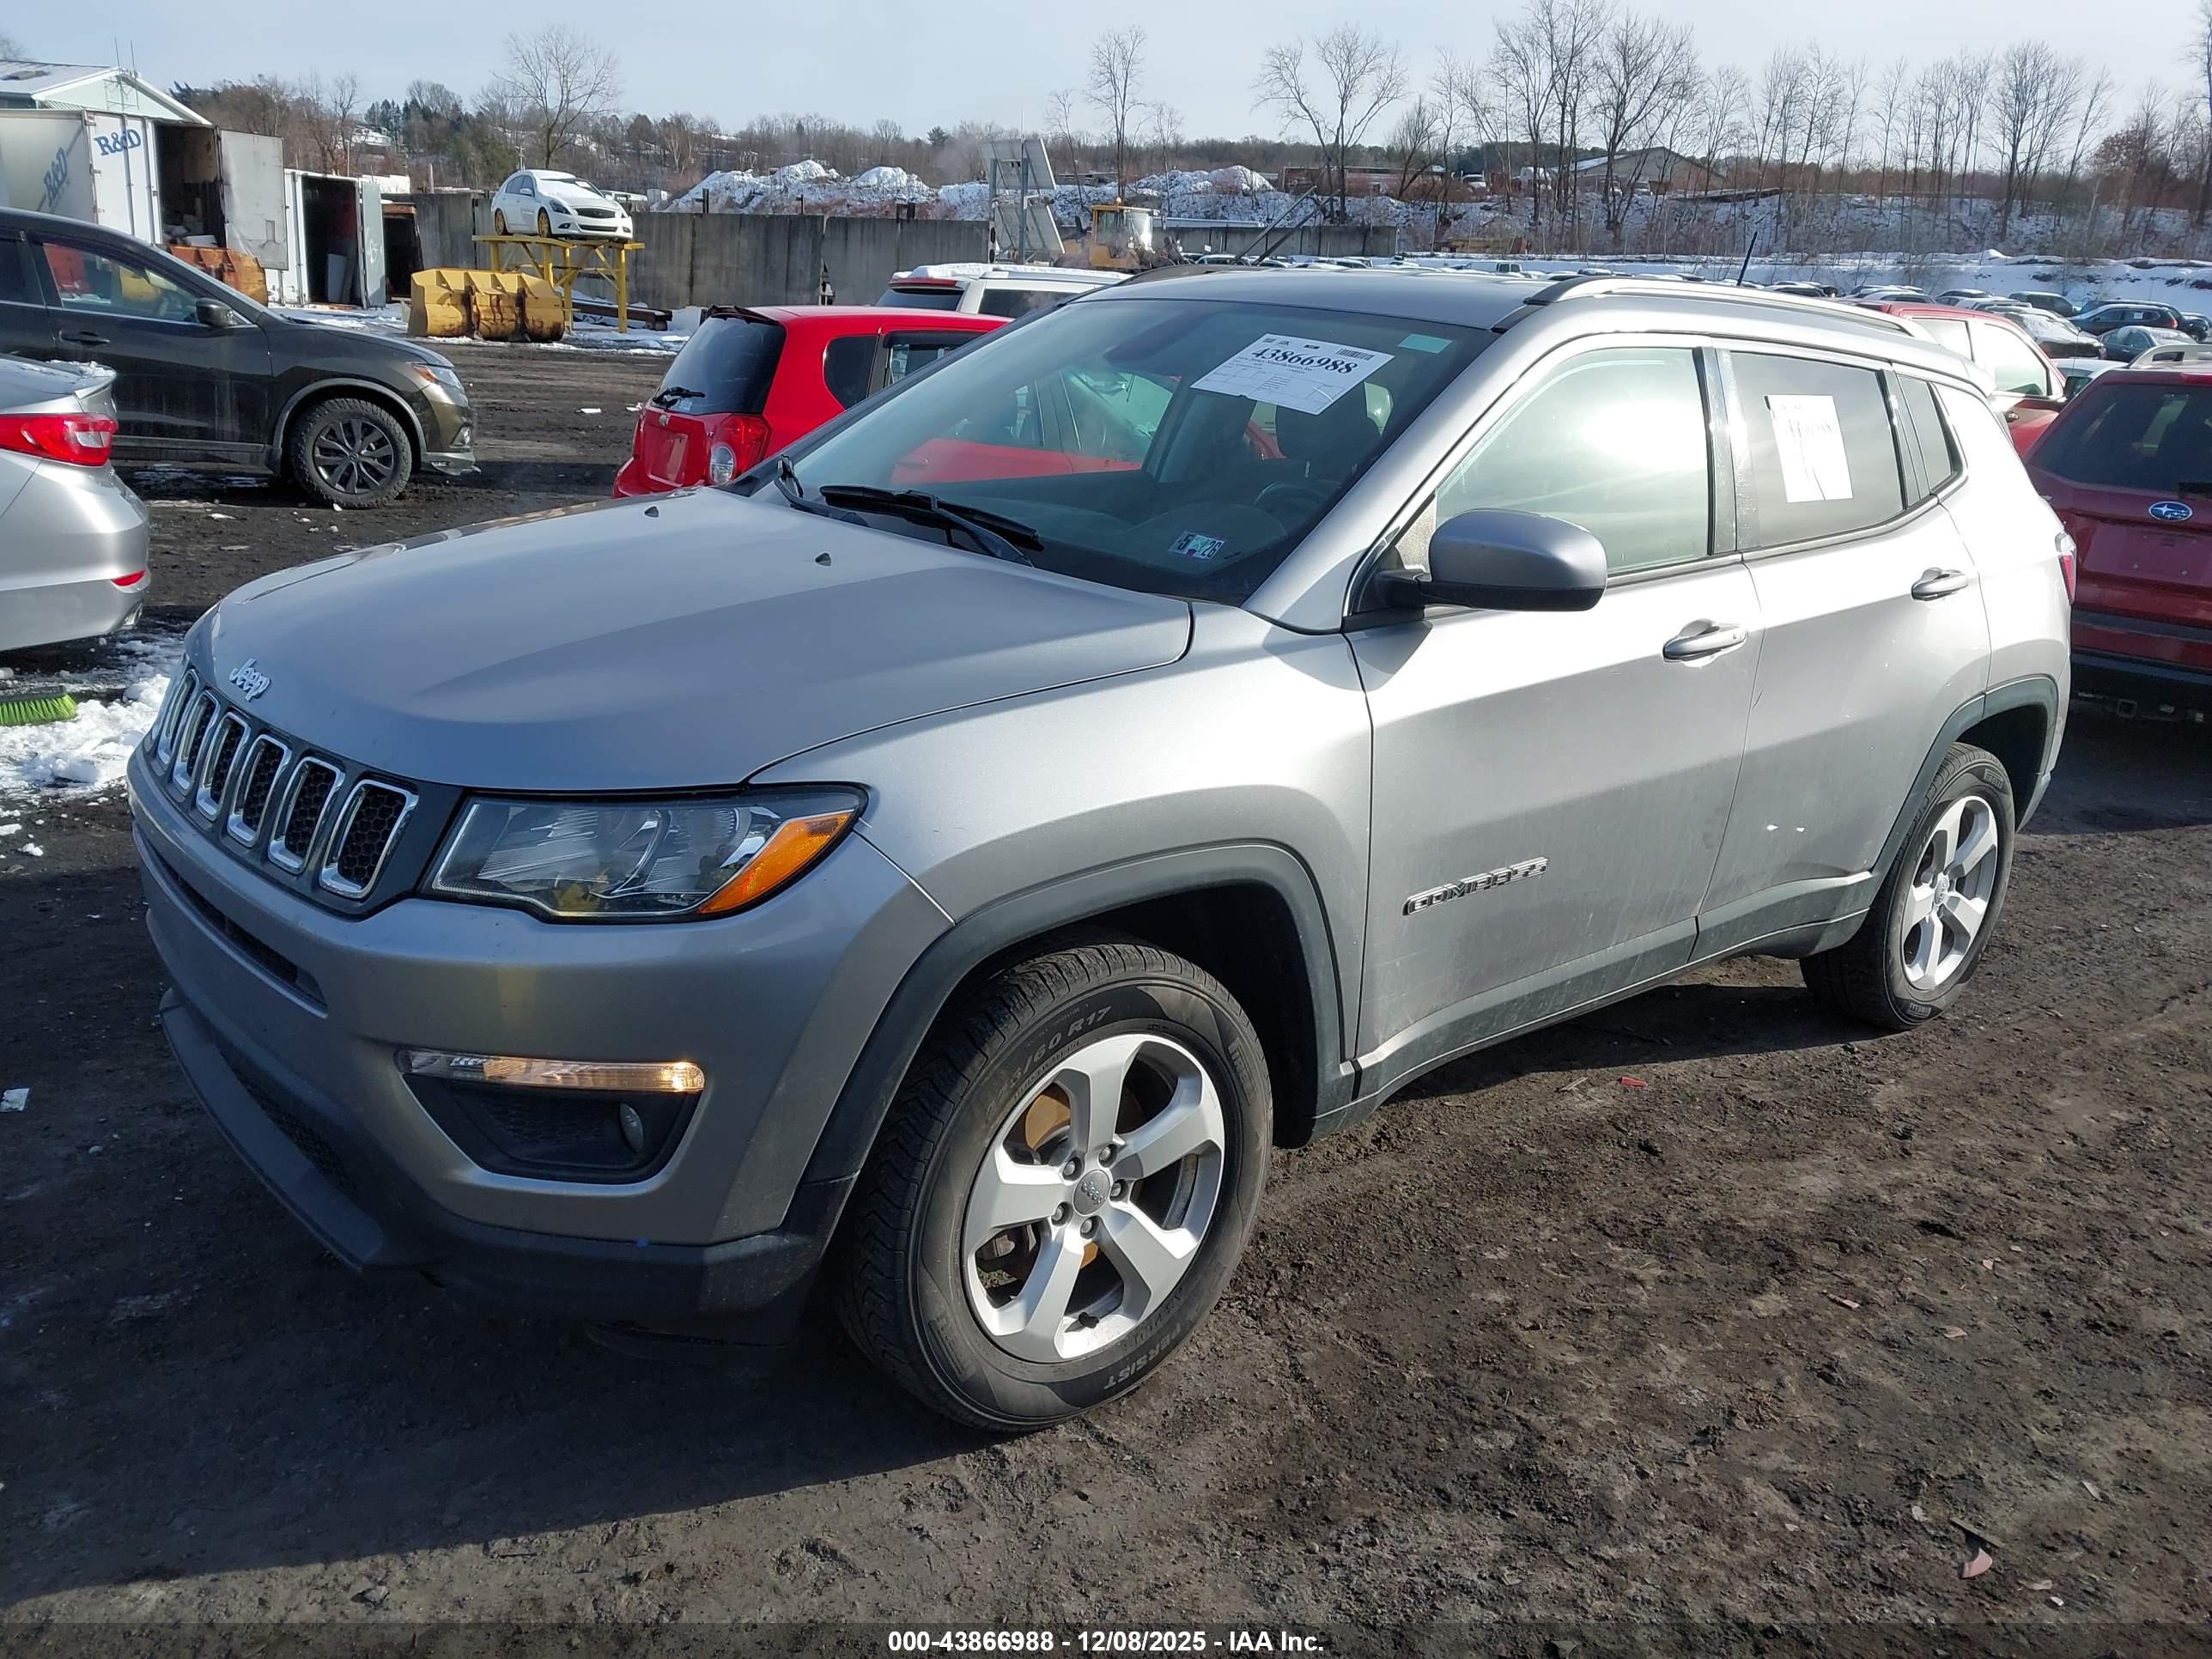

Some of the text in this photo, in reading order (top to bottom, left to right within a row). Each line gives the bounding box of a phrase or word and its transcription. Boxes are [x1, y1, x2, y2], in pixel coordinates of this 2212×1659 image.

[94, 129, 141, 156] R&D
[1251, 347, 1358, 374] 43866988
[1176, 533, 1222, 558] 5 26
[228, 658, 271, 702] Jeep
[1402, 855, 1549, 917] COMPASS
[1067, 1006, 1113, 1037] R17
